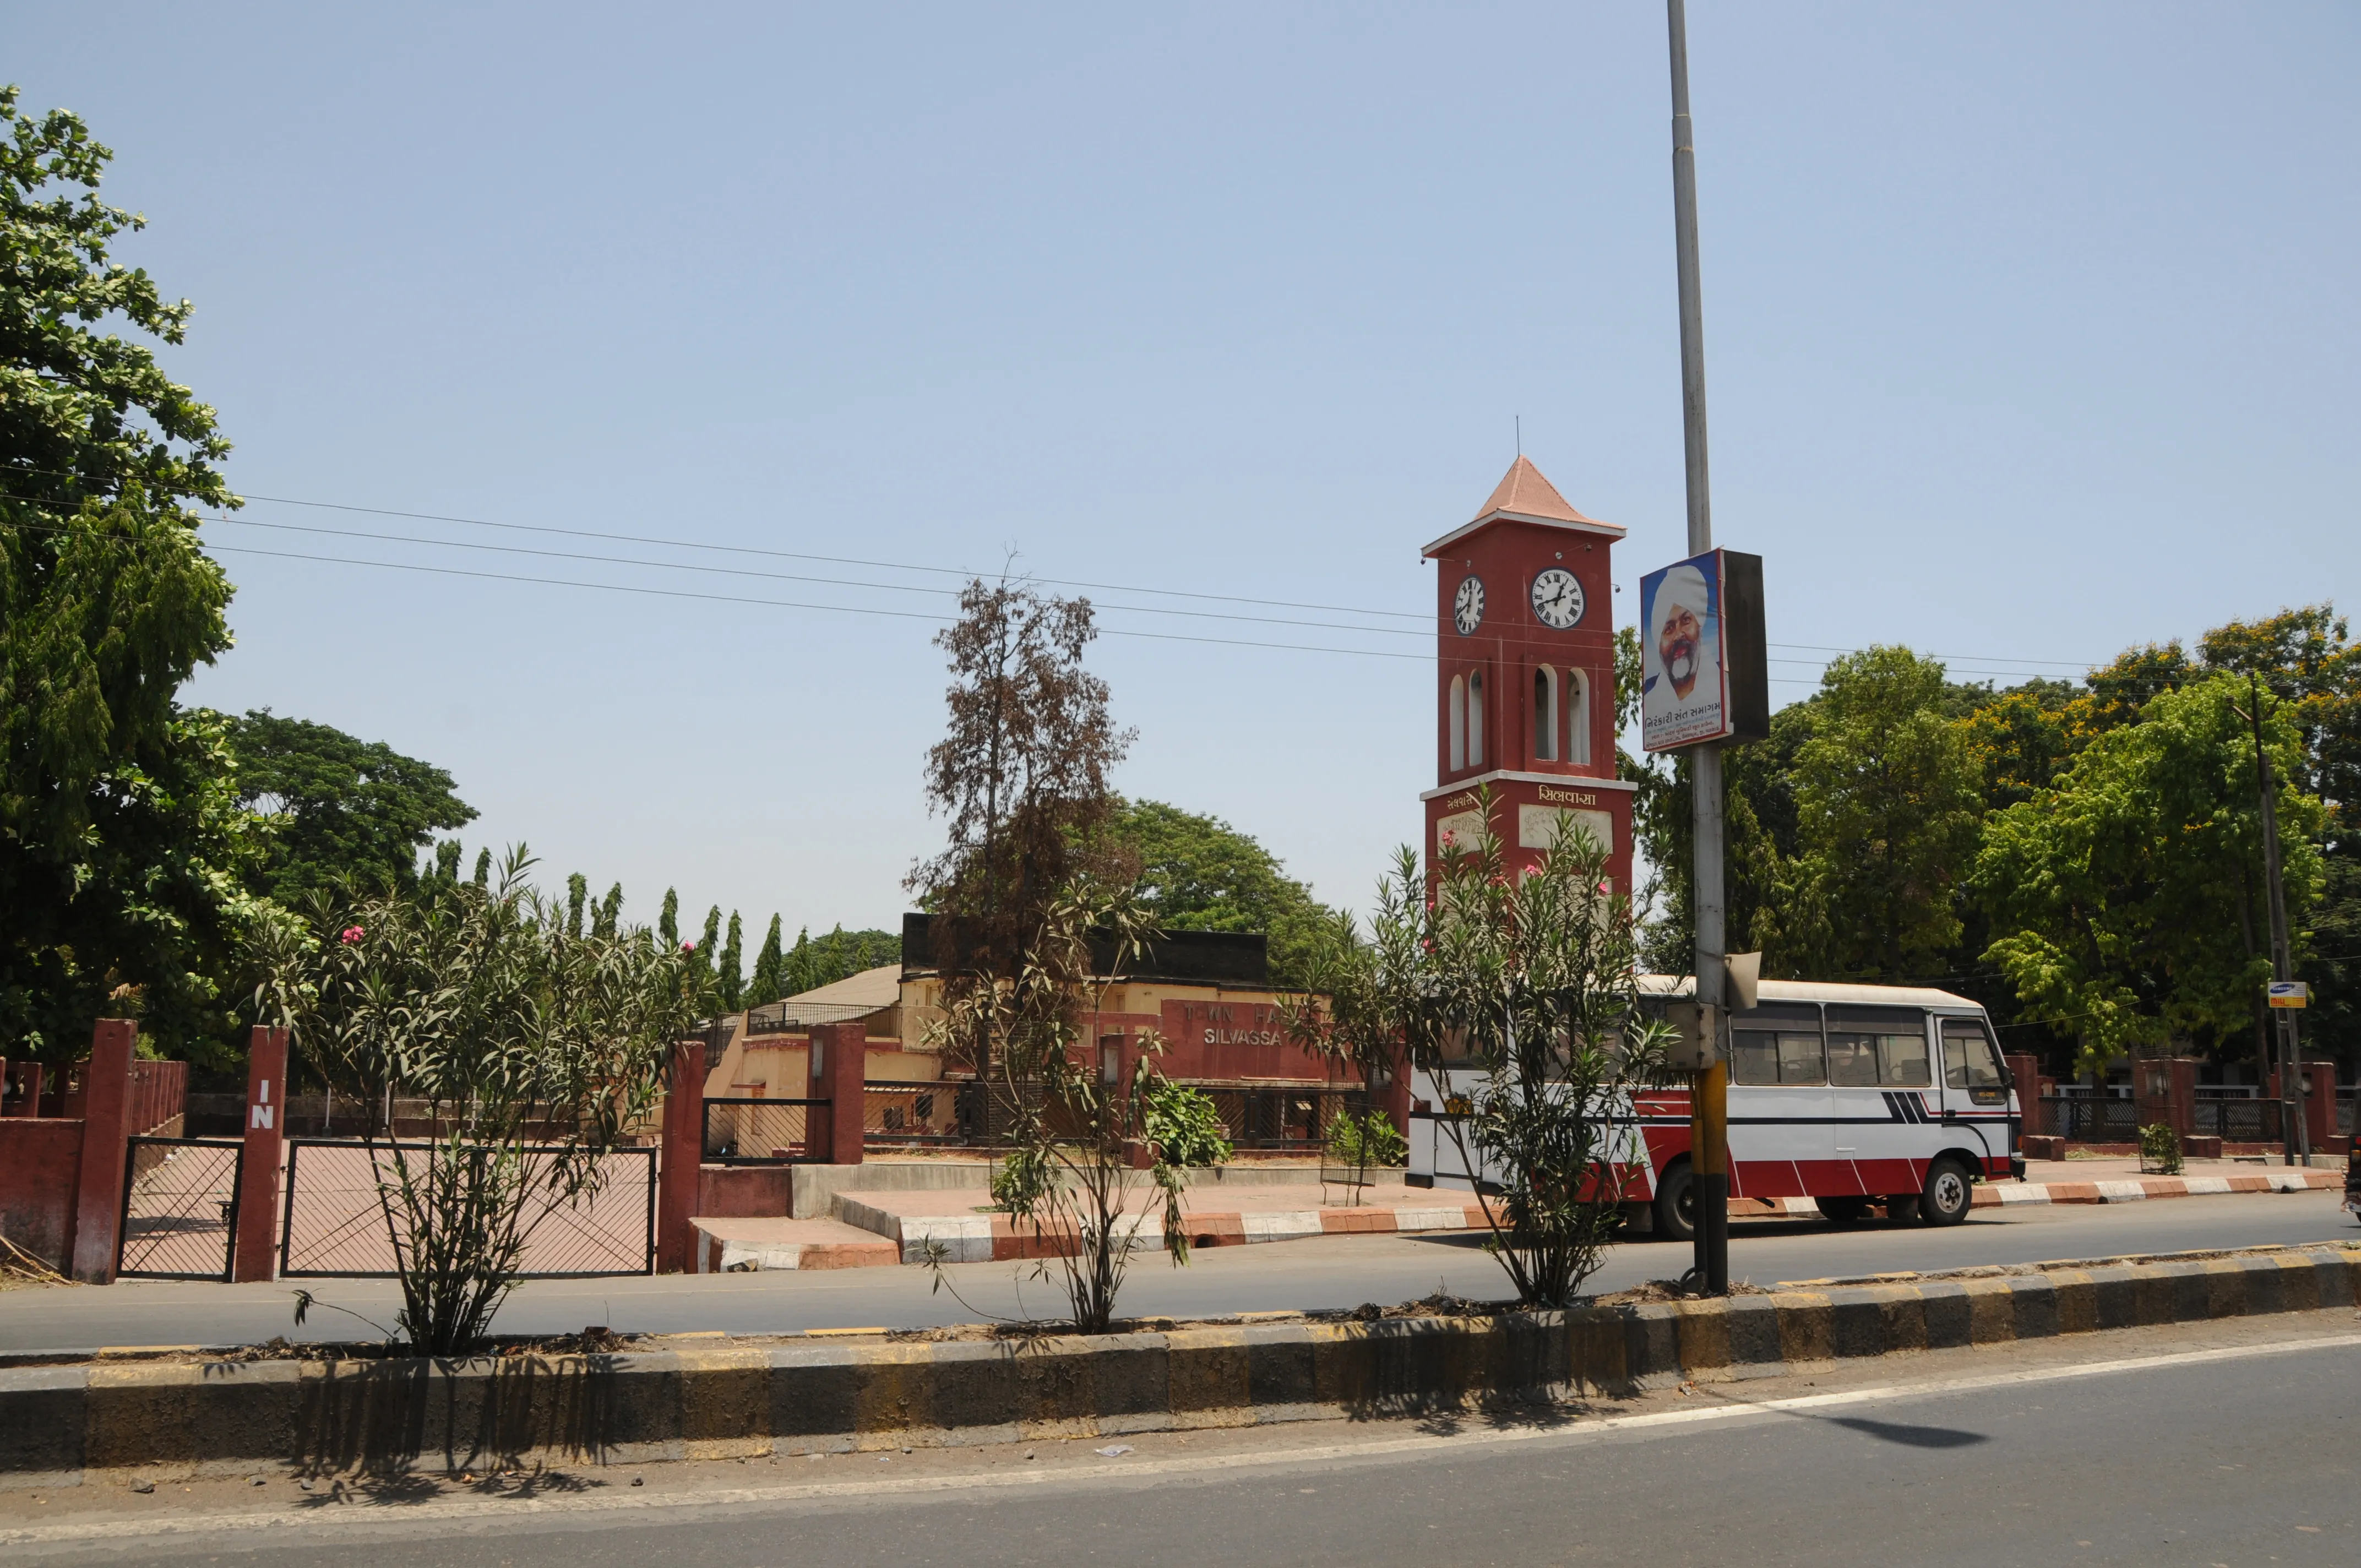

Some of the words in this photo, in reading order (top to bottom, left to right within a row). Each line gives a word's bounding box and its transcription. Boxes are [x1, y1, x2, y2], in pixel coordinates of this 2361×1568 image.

[1645, 712, 1672, 729] નિરંકારી
[1674, 709, 1688, 721] સંત
[1690, 702, 1720, 716] સમાગમ
[1538, 785, 1596, 805] सिलवासा
[1204, 1028, 1282, 1046] SILVASSA
